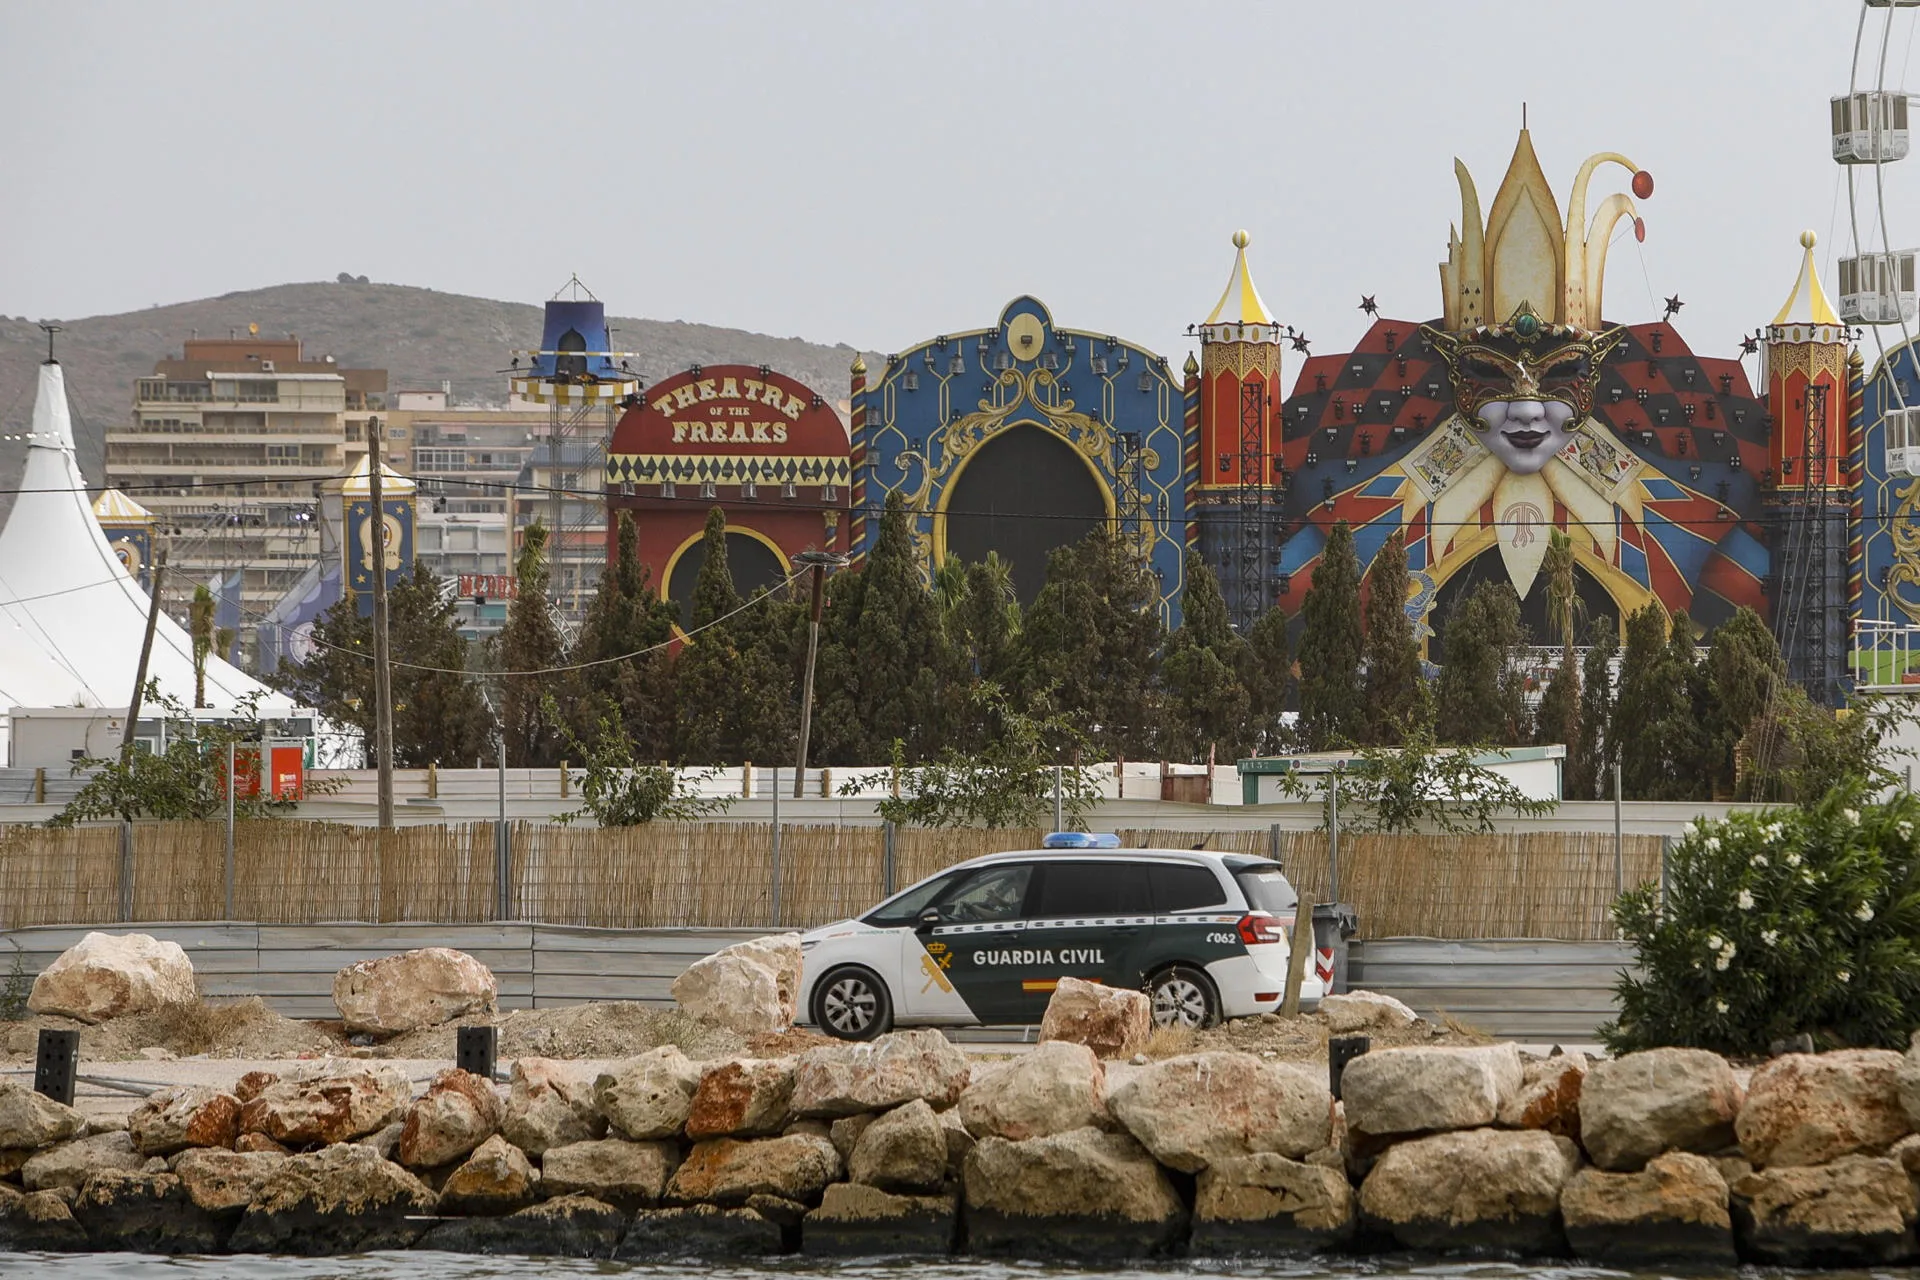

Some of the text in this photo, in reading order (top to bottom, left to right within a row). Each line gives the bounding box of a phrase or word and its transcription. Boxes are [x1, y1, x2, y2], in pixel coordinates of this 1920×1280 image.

[651, 377, 807, 421] THEATRE
[709, 407, 751, 416] OF THE
[671, 421, 789, 444] FREAKS
[973, 949, 1105, 965] GUARDIA CIVIL
